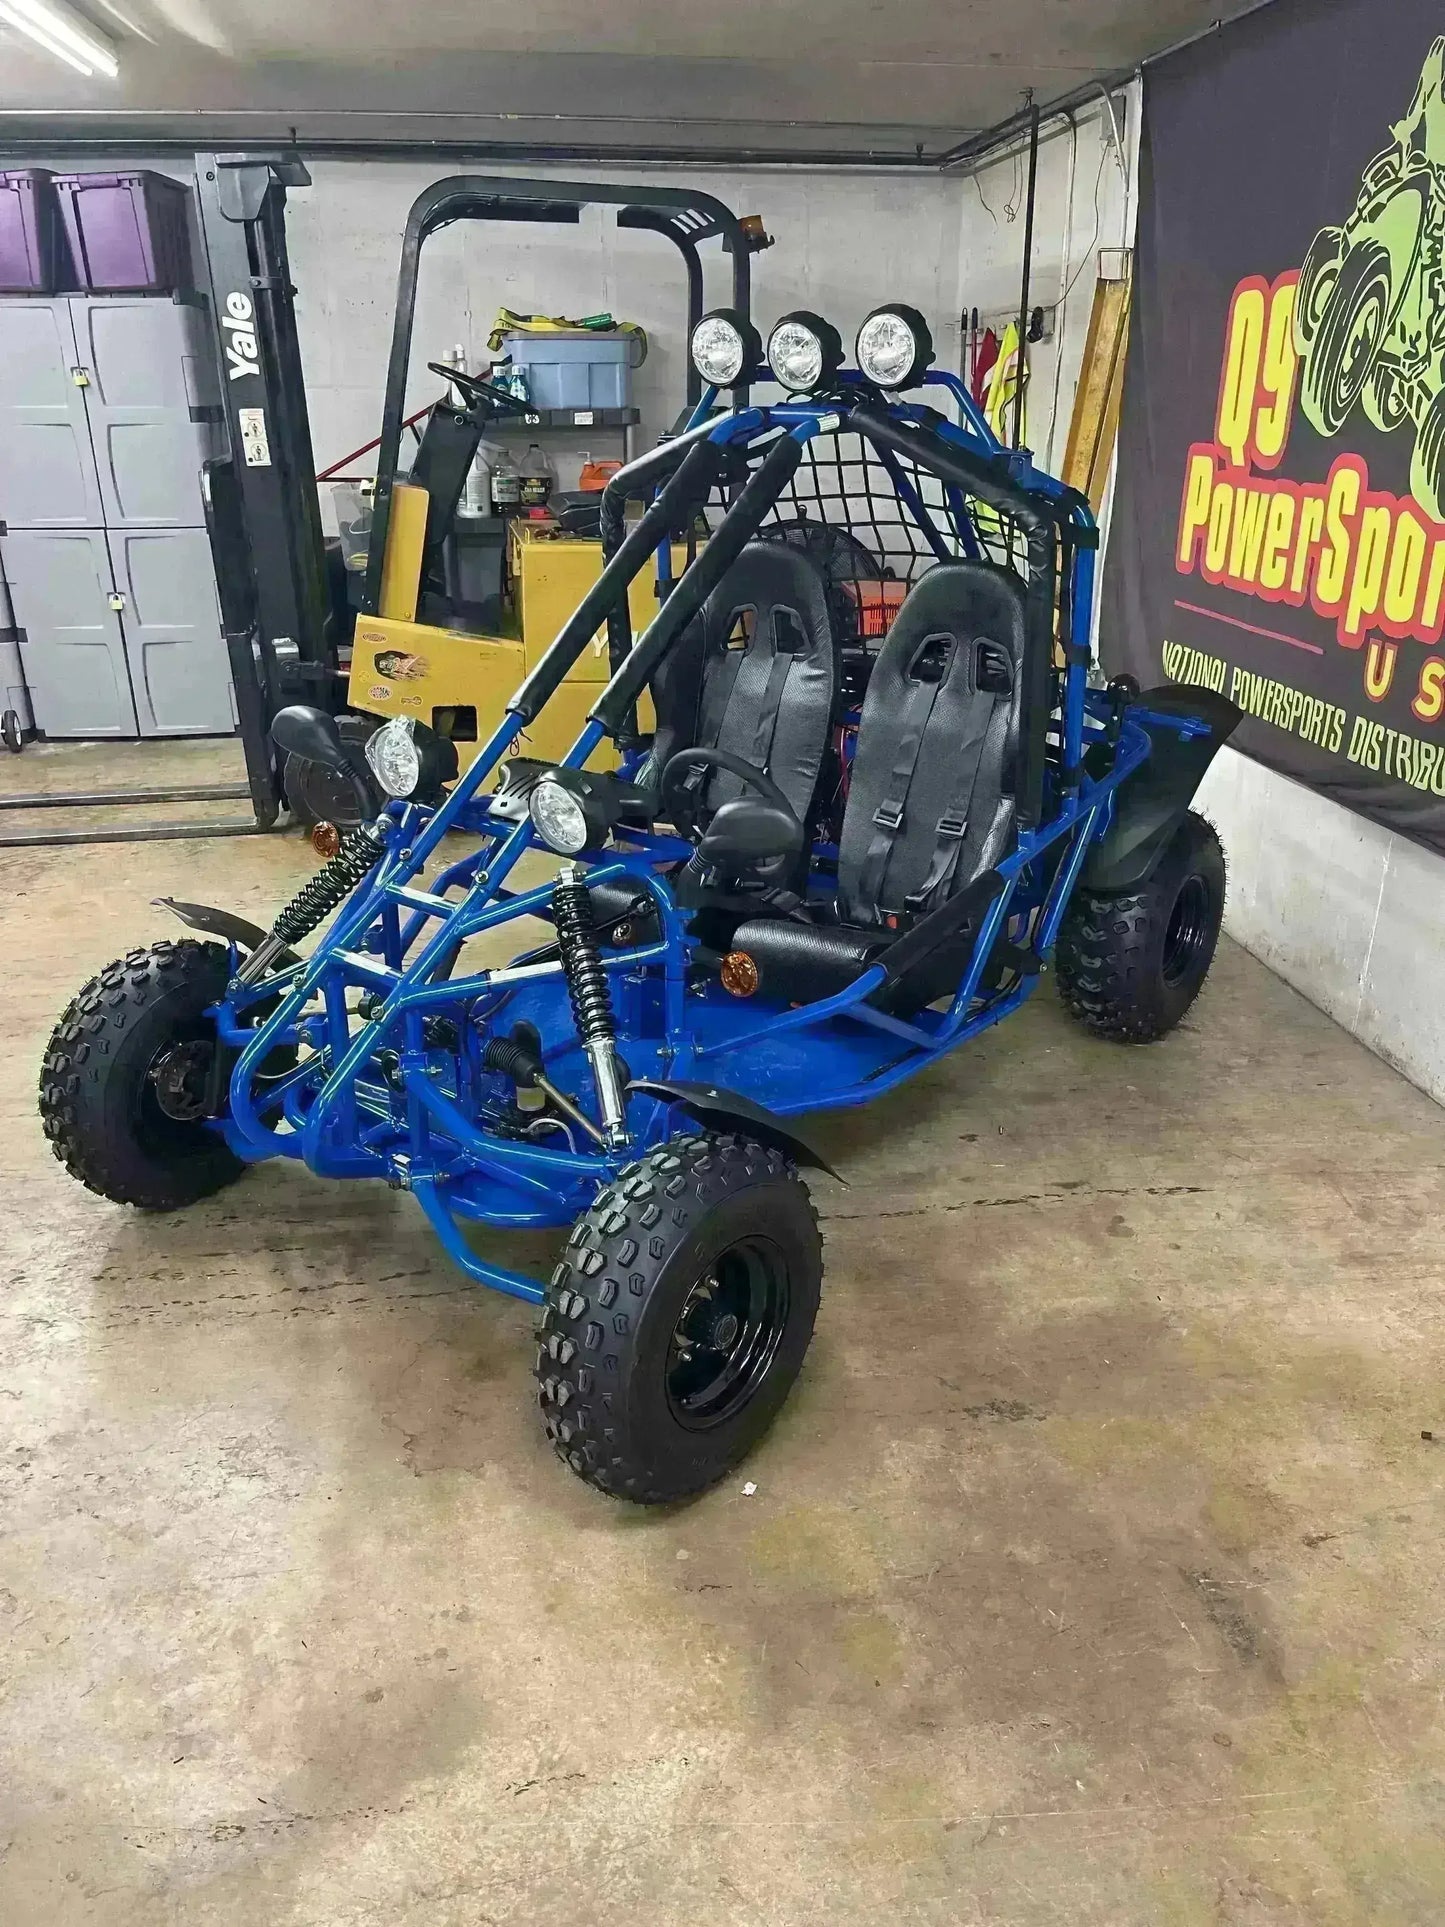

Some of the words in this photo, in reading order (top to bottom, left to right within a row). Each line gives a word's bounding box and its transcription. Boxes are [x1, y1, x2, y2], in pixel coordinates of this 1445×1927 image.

[221, 291, 261, 381] Yale
[1218, 282, 1298, 467] Q9
[1229, 666, 1347, 754] POWERSPORTS
